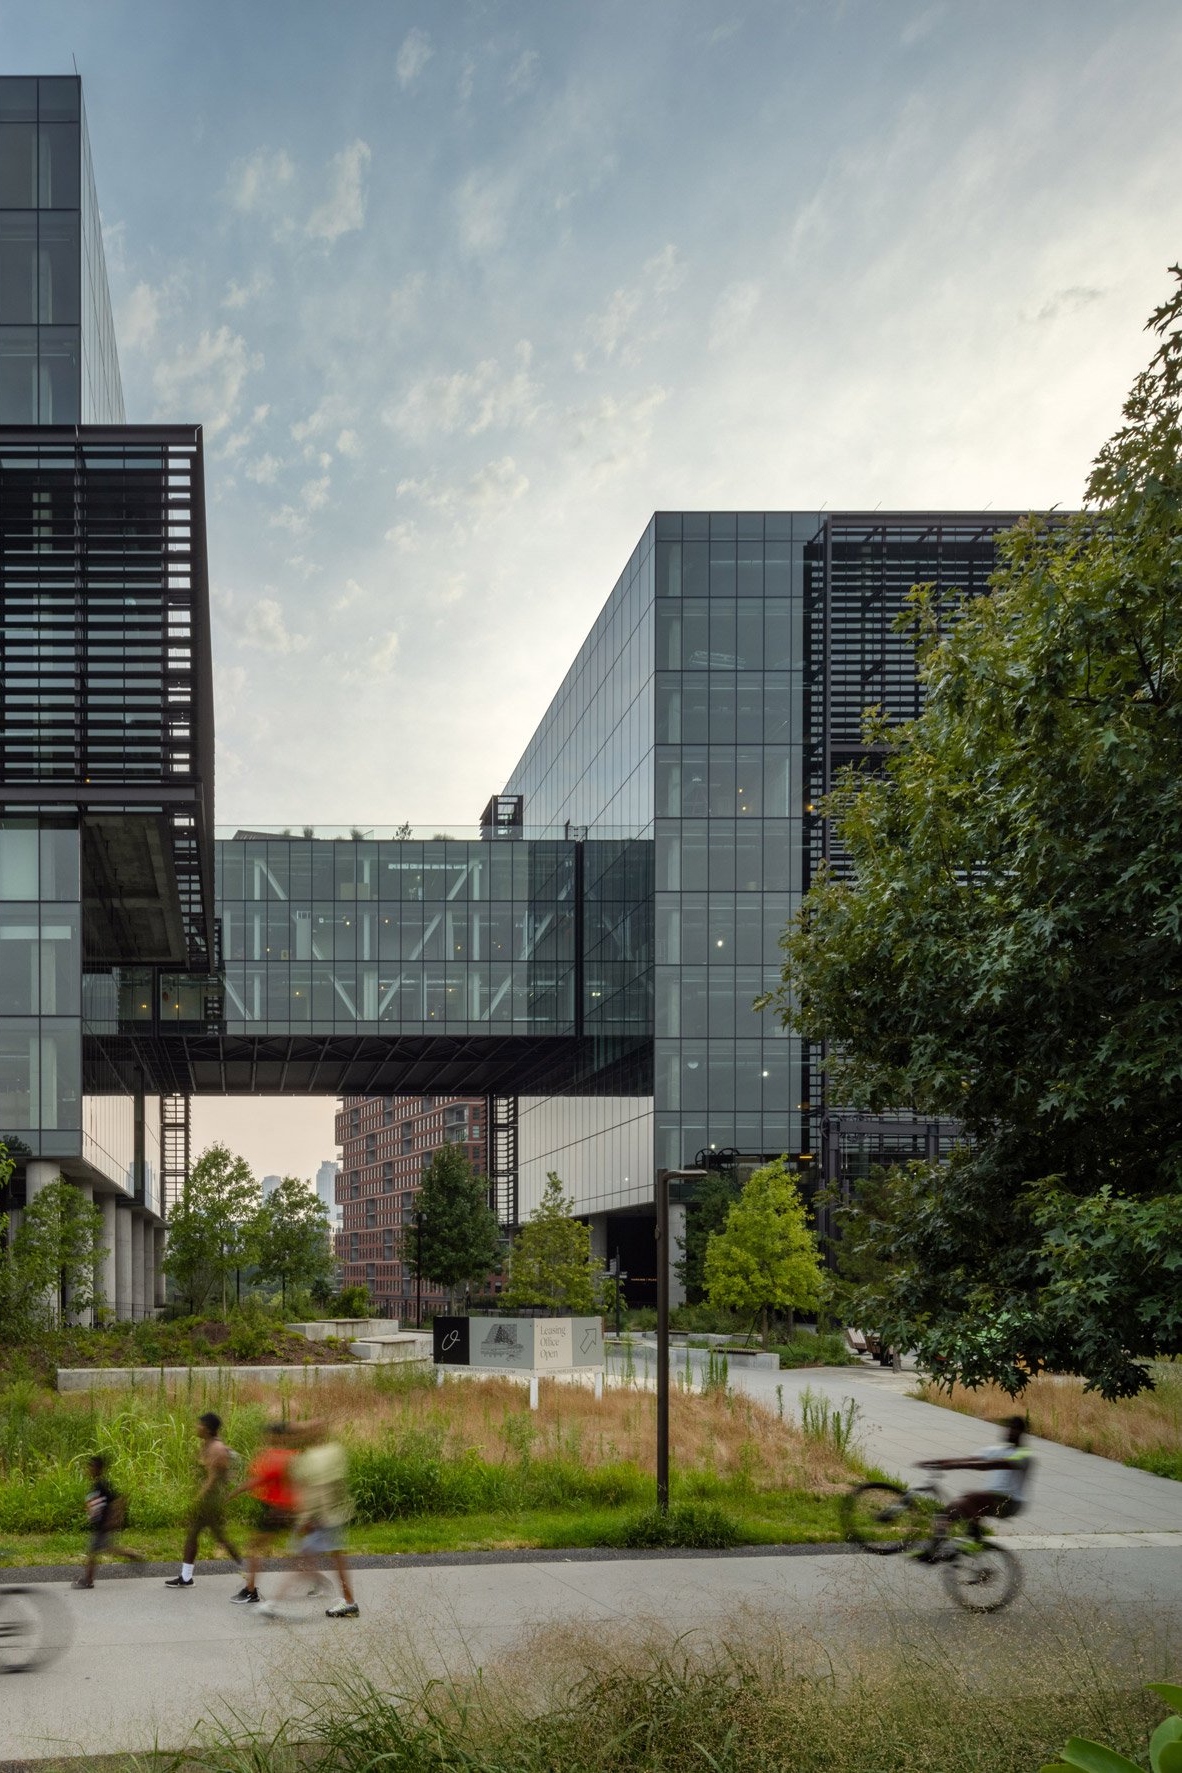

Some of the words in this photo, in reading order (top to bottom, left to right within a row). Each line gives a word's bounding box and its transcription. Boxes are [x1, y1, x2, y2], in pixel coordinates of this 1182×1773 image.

[540, 1325, 567, 1338] Leasing
[539, 1337, 560, 1347] Office
[539, 1349, 559, 1361] Open
